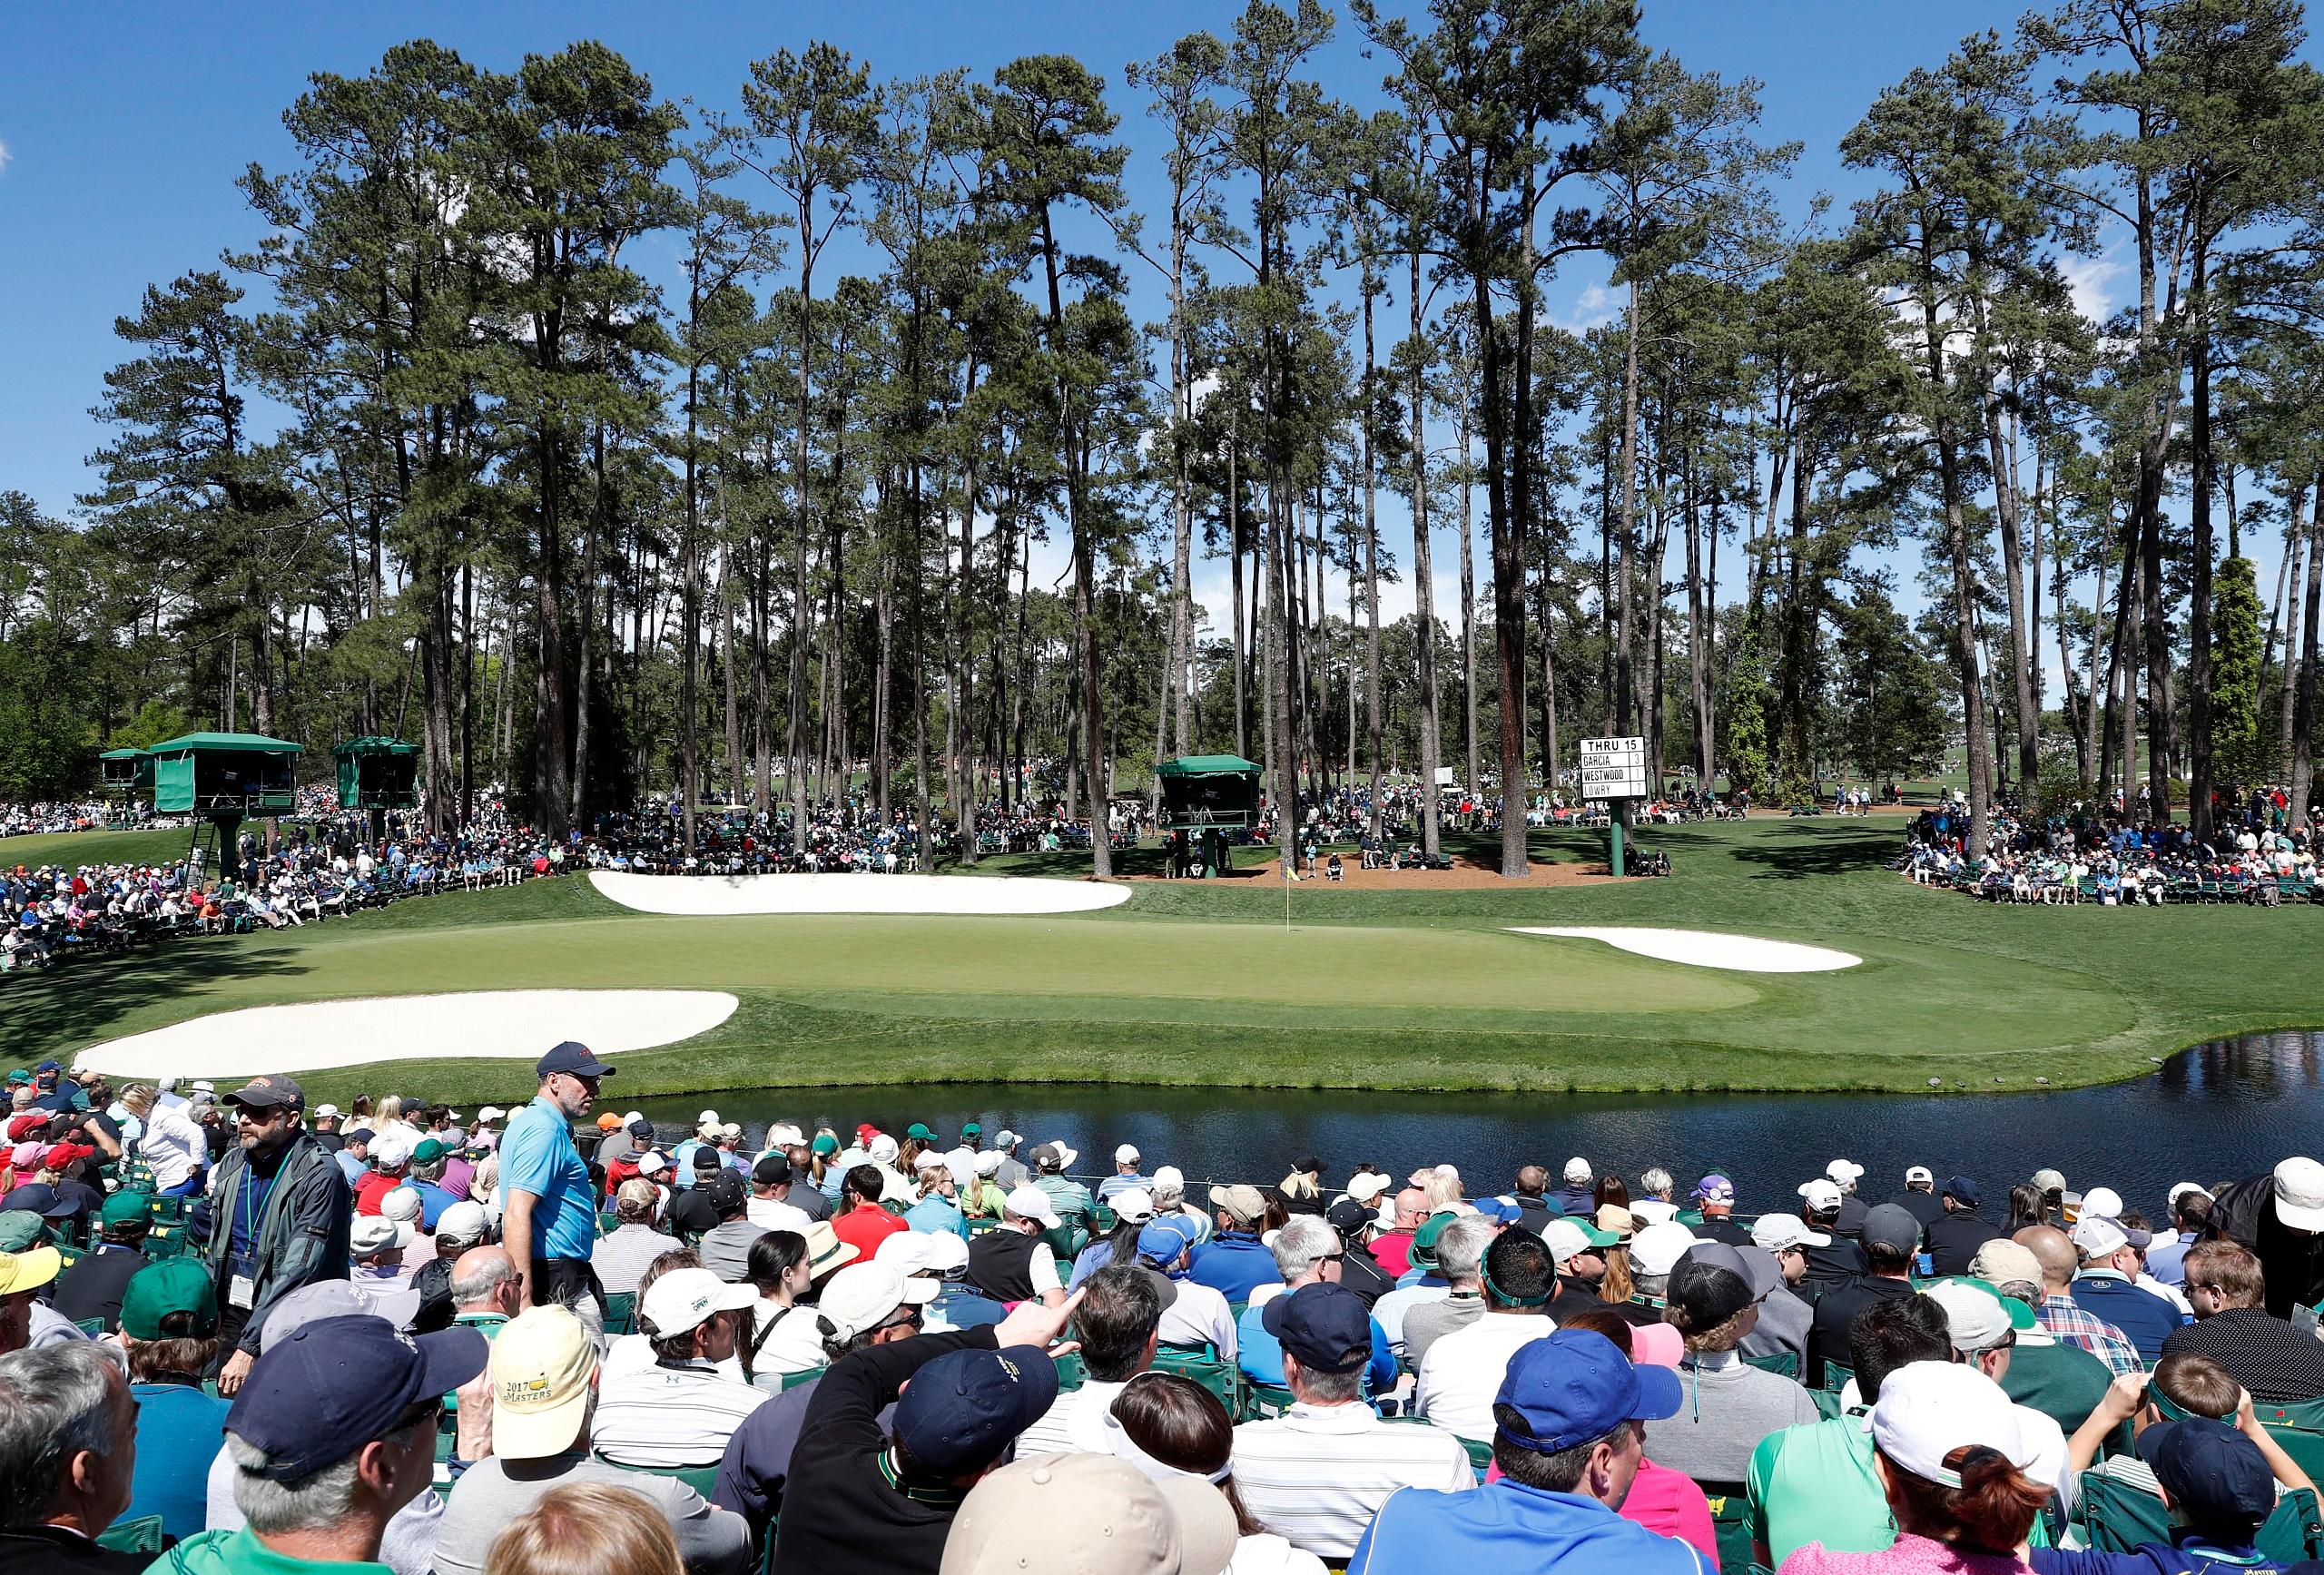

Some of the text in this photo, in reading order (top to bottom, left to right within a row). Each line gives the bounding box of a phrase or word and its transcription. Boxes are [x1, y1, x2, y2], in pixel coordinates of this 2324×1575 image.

[1588, 740, 1637, 752] THRU 15
[1583, 753, 1640, 767] GARCIA 3
[1583, 769, 1624, 782] WESTWOOD
[1584, 783, 1641, 796] LOWRY 7
[1773, 1235, 1797, 1248] SLDR
[507, 1382, 529, 1393] 2017
